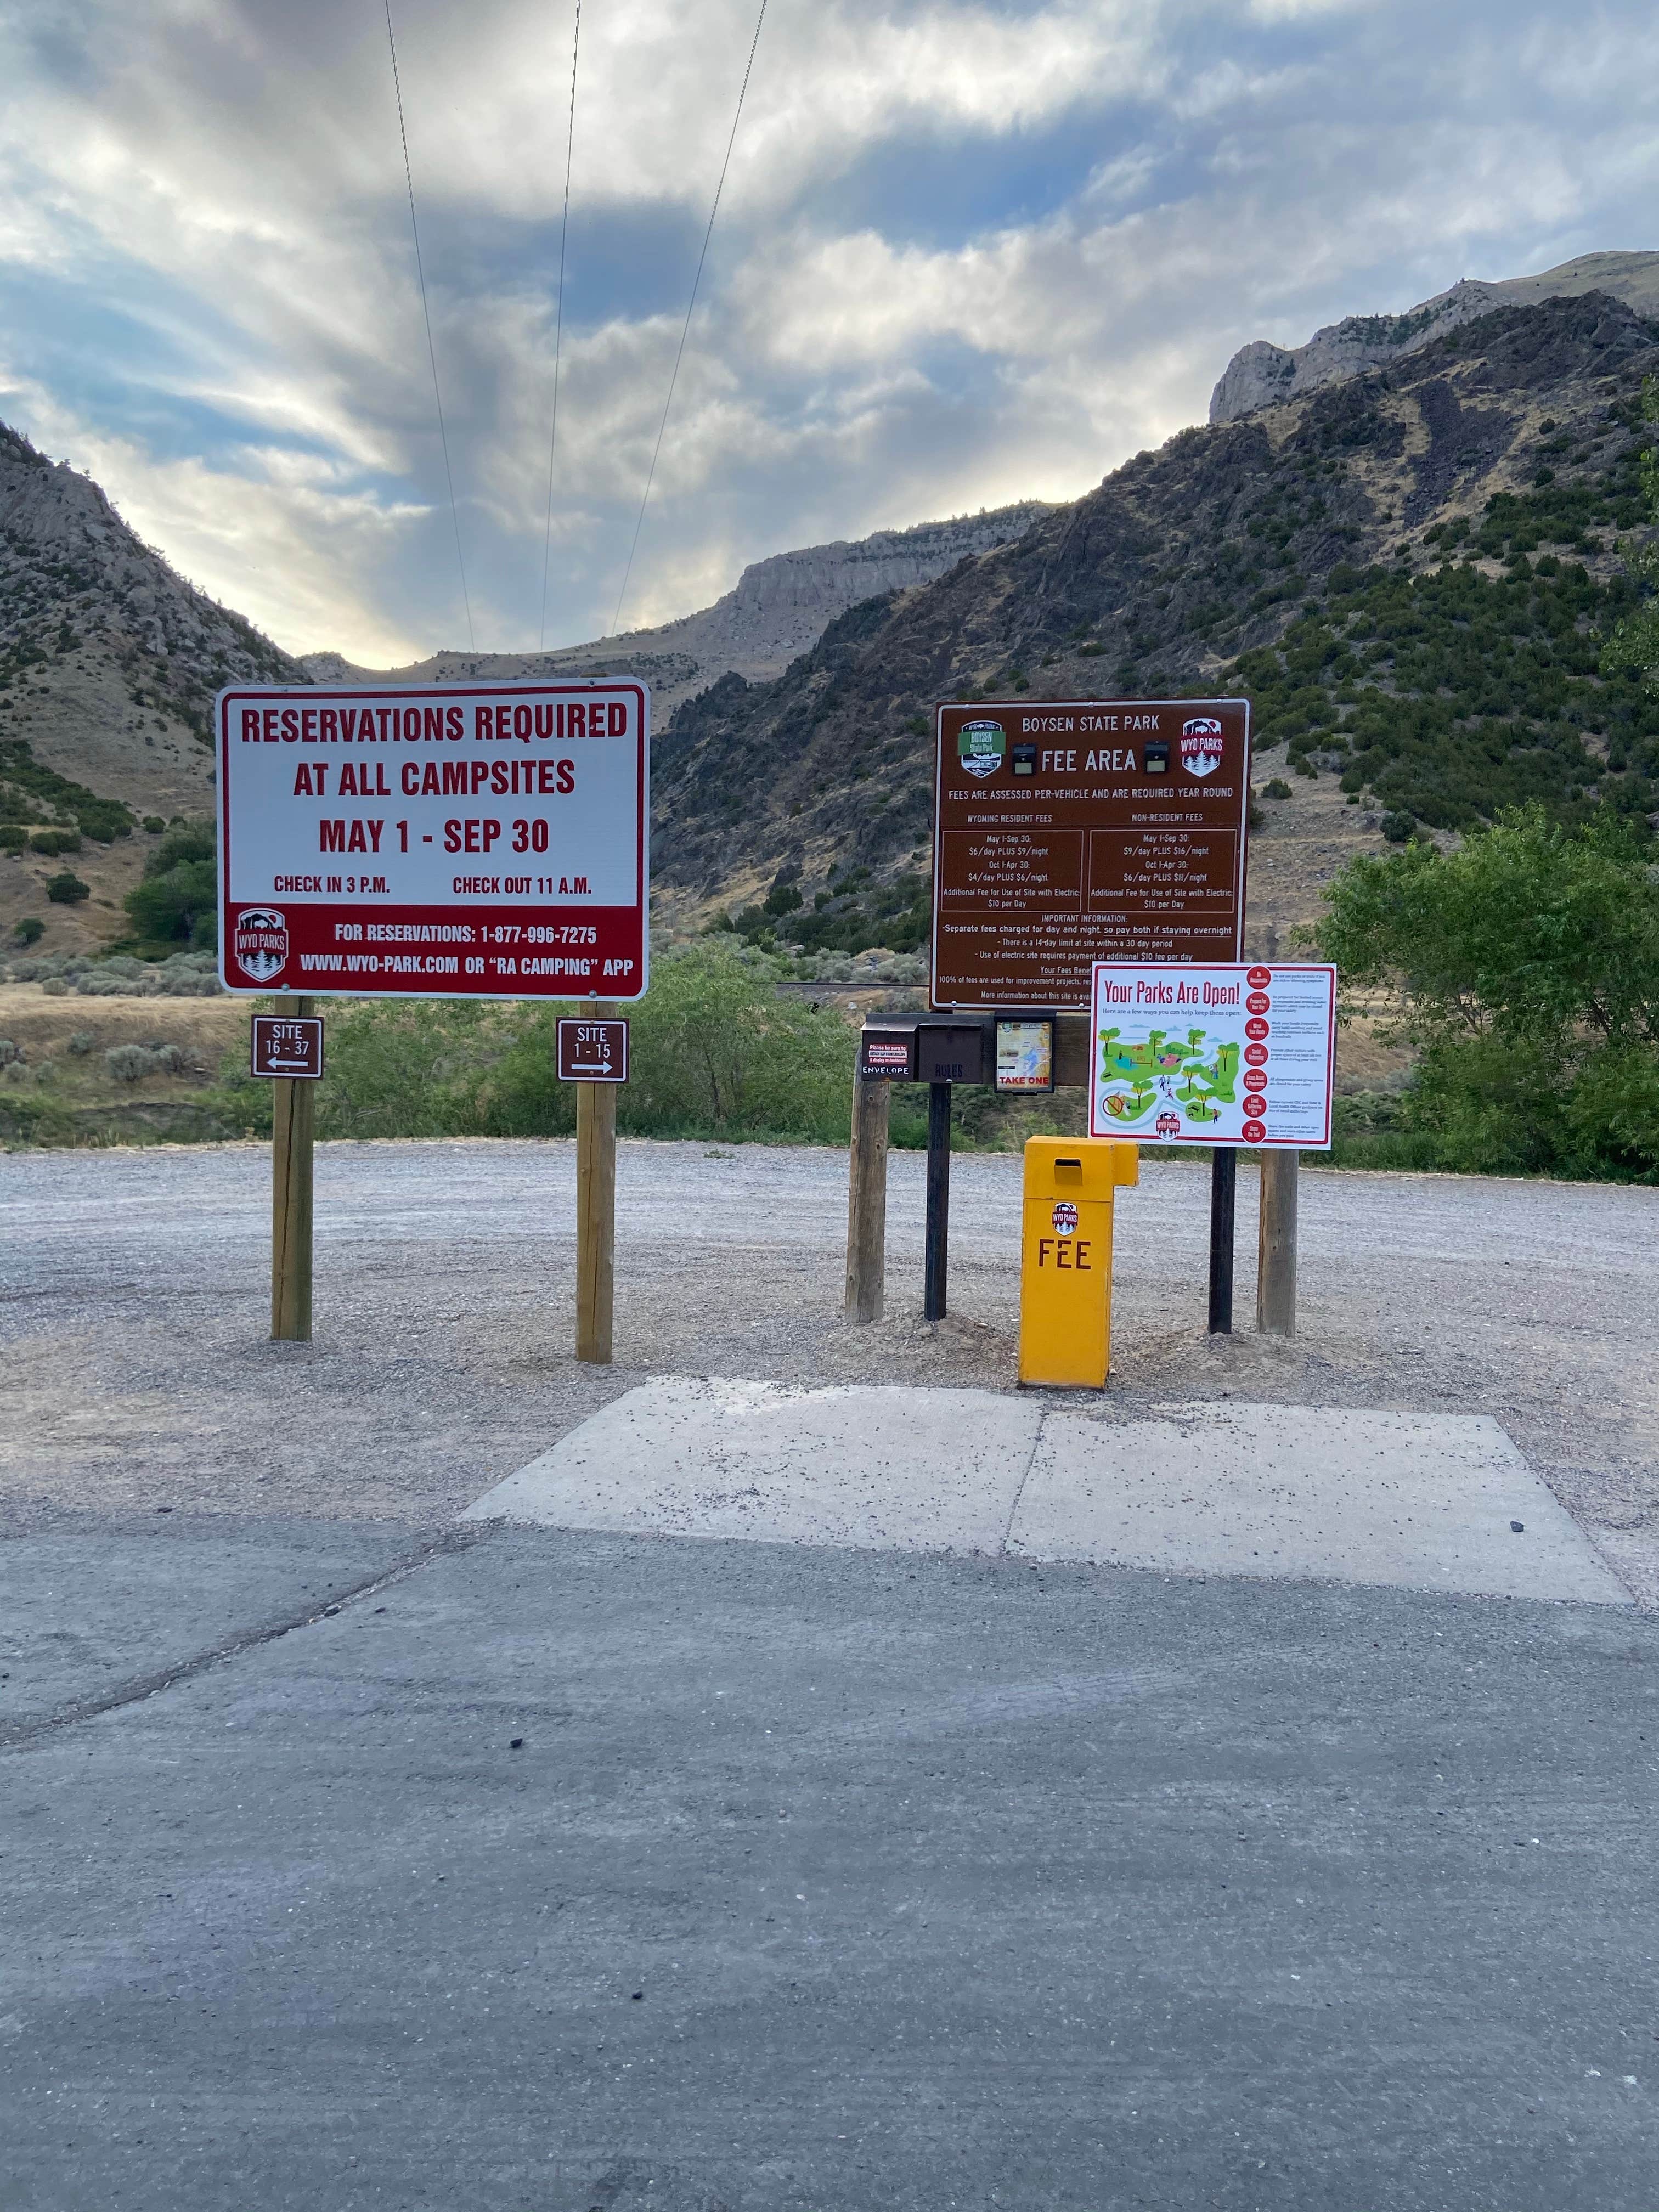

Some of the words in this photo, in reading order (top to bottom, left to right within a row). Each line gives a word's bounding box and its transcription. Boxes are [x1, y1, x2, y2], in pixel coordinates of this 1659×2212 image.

[242, 707, 464, 742] RESERVATIONS
[476, 703, 627, 743] REQUIRED
[1022, 716, 1074, 732] BOYSEN
[1080, 716, 1119, 732] STATE
[1124, 715, 1160, 730] PARK
[971, 732, 992, 743] BOYSEN
[1181, 739, 1197, 752] WYO
[1199, 739, 1222, 751] PARKS
[1042, 751, 1077, 771] FEE
[1085, 749, 1137, 771] AREA
[294, 763, 329, 796] AT
[339, 763, 390, 795] ALL
[402, 759, 575, 795] CAMPSITES
[949, 790, 968, 799] FEES
[972, 790, 988, 799] ARE
[990, 790, 1031, 799] ASSESSED
[1035, 789, 1088, 799] PER-VEHICLE
[1092, 789, 1109, 799] AND
[1113, 789, 1128, 798] ARE
[1132, 789, 1174, 798] REQUIRED
[1178, 788, 1200, 798] YEAR
[1203, 788, 1233, 798] ROUND
[319, 820, 384, 853] MAY
[397, 820, 408, 853] 1
[444, 819, 501, 853] SEP
[512, 819, 549, 853] 30
[986, 836, 1000, 844] May
[1143, 834, 1157, 843] May
[969, 847, 995, 857] $6/day
[1018, 847, 1048, 857] $9/night
[1124, 846, 1151, 856] $9/day
[1173, 846, 1209, 857] $16/night
[968, 872, 994, 882] $4/day
[1017, 872, 1048, 883] $6/night
[1124, 872, 1151, 882] $6/day
[274, 876, 323, 893] CHECK
[327, 877, 343, 893] IN
[347, 877, 355, 893] 3
[360, 877, 390, 893] P.M.
[453, 877, 500, 894] CHECK
[505, 878, 531, 894] OUT
[537, 878, 553, 894] 11
[558, 878, 591, 895] A.M.
[335, 925, 362, 941] FOR
[368, 926, 476, 943] RESERVATIONS:
[481, 926, 596, 944] 1-877-996-7275
[942, 924, 978, 933] -Separate
[999, 926, 1029, 934] charged
[1161, 927, 1190, 935] staying
[239, 934, 257, 949] WYO
[259, 934, 284, 950] PARKS
[1035, 939, 1056, 947] 14-day
[1137, 940, 1149, 948] day
[1068, 953, 1096, 961] payment
[1181, 953, 1193, 962] day
[301, 955, 458, 974] WWW.WYO-PARK.COM
[465, 957, 485, 974] OR
[489, 957, 515, 974] “RA
[521, 957, 599, 976] CAMPING”
[603, 959, 633, 976] APP
[1105, 980, 1132, 1002] Your
[1137, 981, 1172, 1003] Parks
[1177, 981, 1198, 1004] Are
[1203, 982, 1240, 1007] Open!
[273, 1025, 303, 1039] SITE
[577, 1027, 607, 1041] SITE
[266, 1040, 280, 1054] 16
[294, 1041, 309, 1054] 37
[574, 1043, 579, 1057] 1
[596, 1044, 610, 1058] 15
[863, 1066, 909, 1075] ENVELOPE
[1064, 1214, 1077, 1222] PARKS
[1039, 1239, 1091, 1269] FEE
